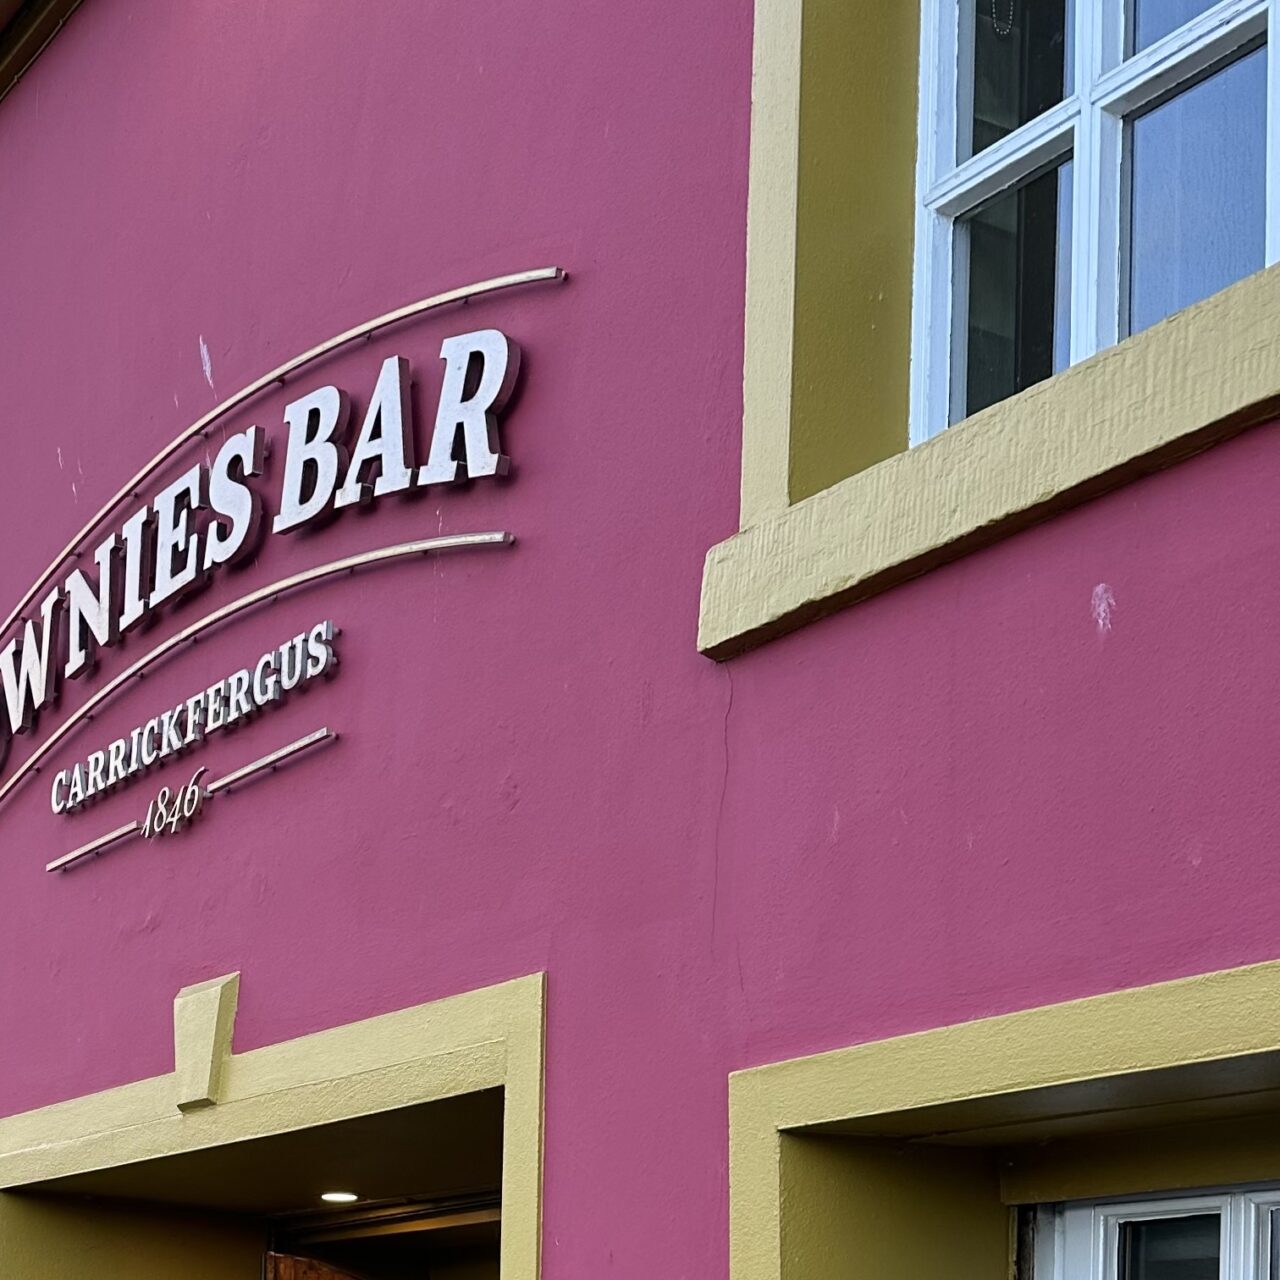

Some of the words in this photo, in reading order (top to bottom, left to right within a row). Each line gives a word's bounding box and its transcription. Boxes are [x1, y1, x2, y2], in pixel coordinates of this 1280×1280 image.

[272, 328, 518, 535] BAR
[50, 620, 334, 815] CARRICKFERGUS
[140, 766, 205, 838] 1846
